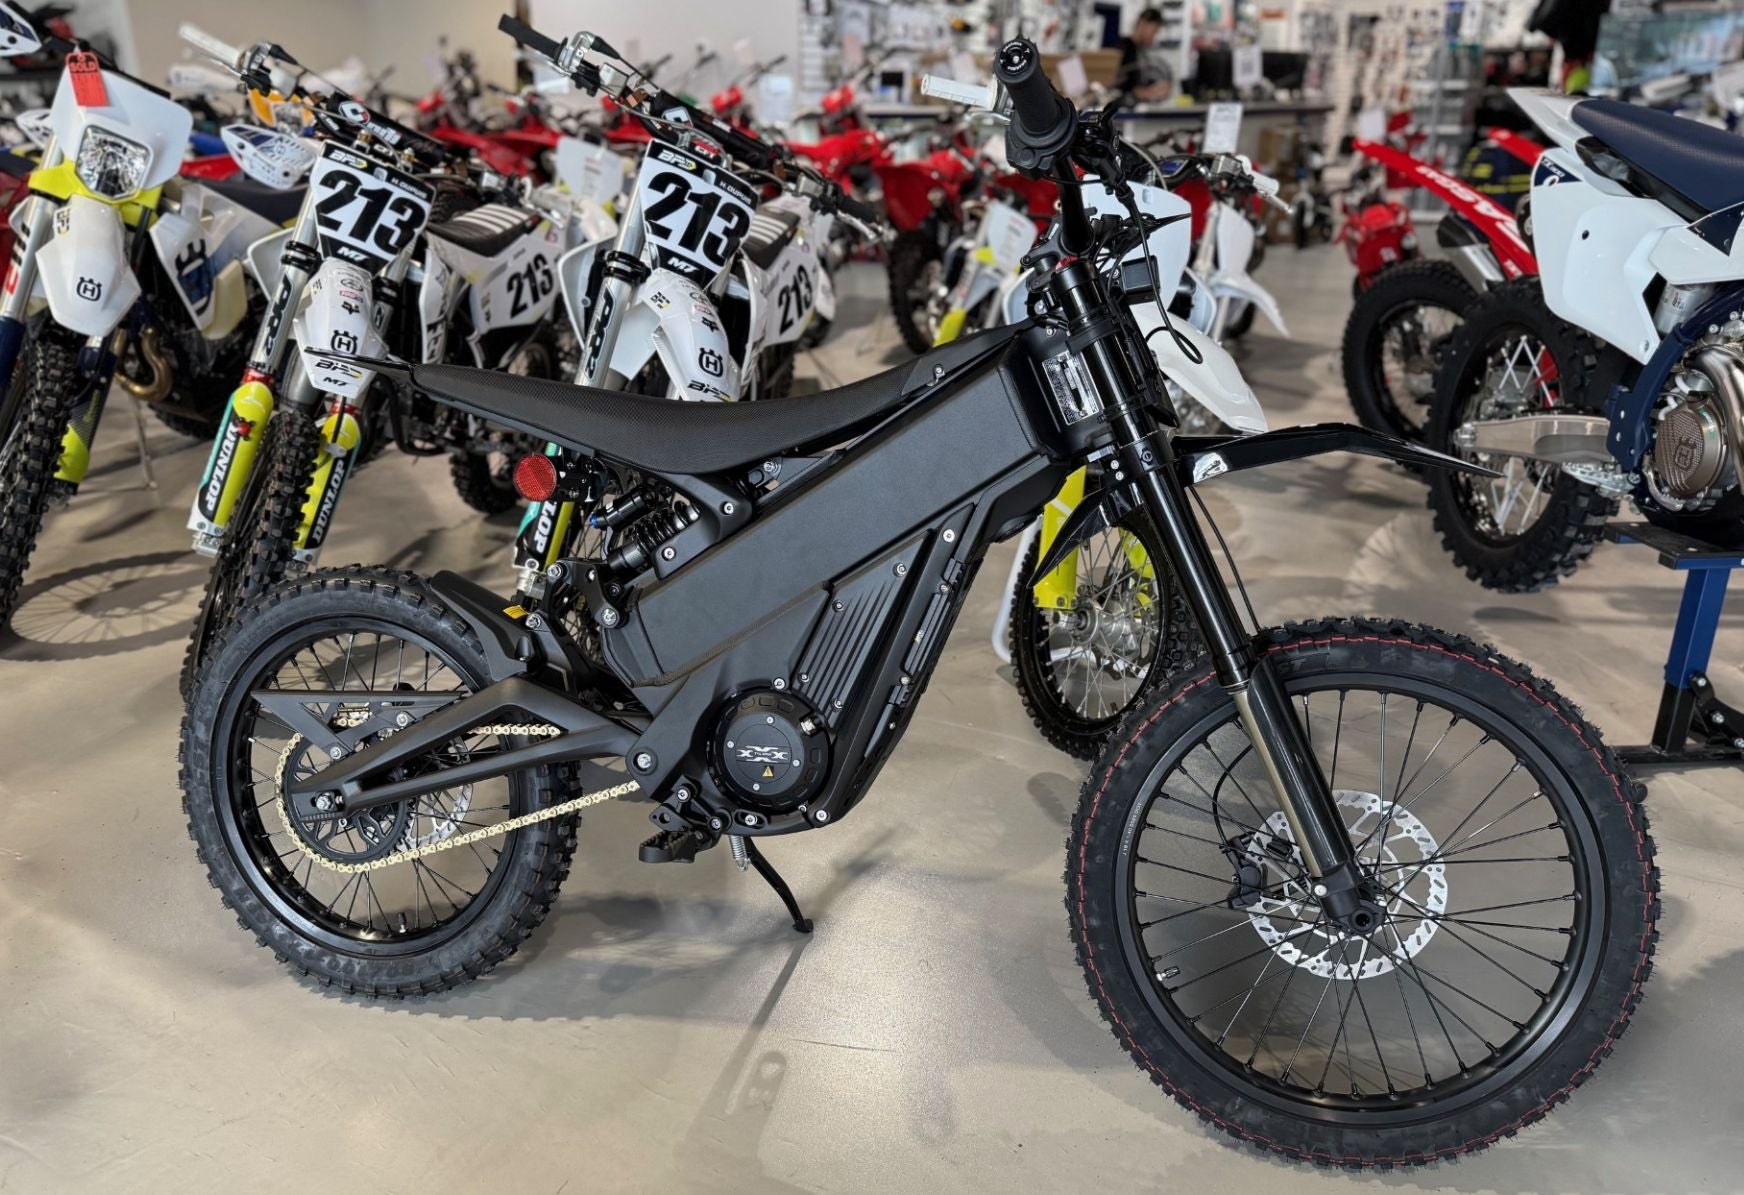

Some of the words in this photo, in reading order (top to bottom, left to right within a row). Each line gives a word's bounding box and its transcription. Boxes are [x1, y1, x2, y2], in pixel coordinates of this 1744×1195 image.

[70, 61, 97, 72] SOLD
[315, 170, 427, 256] 213
[644, 171, 750, 268] 213
[506, 253, 554, 319] 213
[778, 264, 812, 336] 213
[312, 459, 345, 544] DUNLOP
[534, 500, 557, 554] LOP
